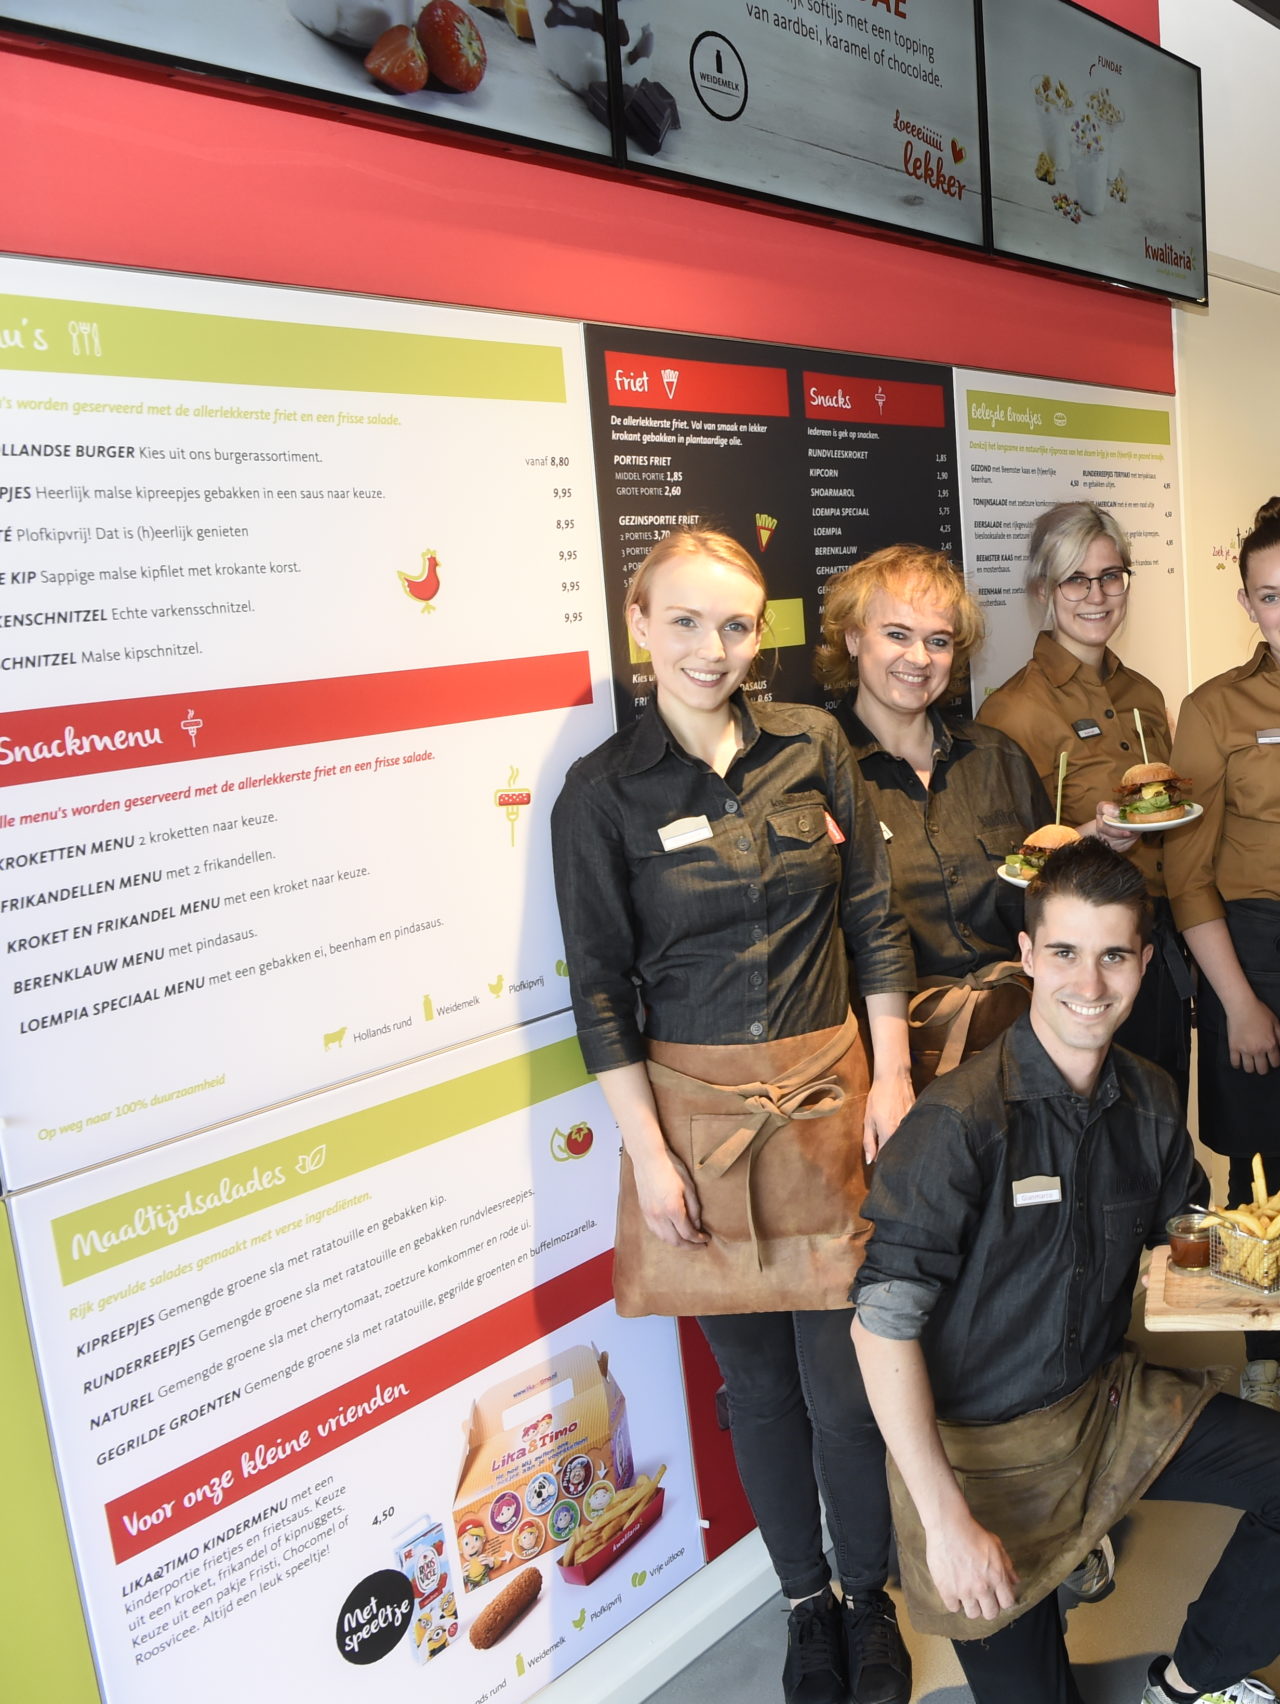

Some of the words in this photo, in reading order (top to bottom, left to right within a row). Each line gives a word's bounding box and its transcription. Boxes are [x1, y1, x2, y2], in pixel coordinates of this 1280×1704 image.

[808, 0, 843, 26] softijs
[847, 14, 869, 34] met
[871, 23, 891, 42] een
[894, 30, 934, 64] topping
[746, 3, 769, 23] van
[773, 13, 822, 45] aardbei,
[825, 27, 870, 61] karamel
[873, 48, 885, 66] of
[887, 53, 942, 88] chocolade.
[1098, 56, 1123, 75] FUNDAE
[700, 72, 740, 92] WEIDEMELK
[904, 141, 966, 200] lekker
[1144, 236, 1192, 271] kwalitaria
[614, 370, 649, 393] friet
[810, 388, 851, 409] Snacks
[610, 415, 621, 425] De
[622, 415, 671, 428] allerlekkerste
[671, 418, 689, 431] friet.
[690, 420, 702, 430] Vol
[717, 422, 738, 431] smaak
[739, 424, 747, 432] en
[748, 423, 767, 433] lekker
[611, 430, 641, 441] krokant
[642, 432, 676, 444] gebakken
[677, 433, 684, 443] in
[685, 434, 728, 447] plantaardige
[728, 436, 742, 445] olie.
[2, 443, 71, 457] LLANDSE
[76, 445, 135, 458] BURGER
[139, 447, 165, 459] Kies
[169, 447, 186, 460] uit
[189, 450, 211, 460] ons
[214, 448, 322, 464] burgerassortiment.
[525, 455, 548, 466] vanaf
[550, 456, 569, 467] 8,80
[613, 455, 648, 465] PORTIES
[649, 456, 671, 466] FRIET
[808, 448, 868, 459] RUNDVLEESKROKET
[615, 471, 641, 480] MIDDEL
[642, 472, 664, 481] PORTIE
[666, 471, 682, 482] 1,85
[809, 468, 838, 477] KIPCORN
[970, 464, 991, 472] GEZOND
[553, 488, 572, 499] 9,95
[616, 486, 639, 495] GROTE
[640, 487, 663, 495] PORTIE
[664, 486, 681, 497] 2,60
[810, 488, 855, 497] SHOARMAROL
[618, 513, 678, 526] GEZINSPORTIE
[678, 514, 700, 525] FRIET
[812, 507, 840, 516] LOEMPIA
[841, 507, 869, 516] SPECIAAL
[556, 519, 574, 530] 8,95
[813, 527, 842, 536] LOEMPIA
[558, 550, 577, 561] 9,95
[11, 571, 36, 584] KIP
[40, 569, 95, 585] Sappige
[99, 567, 137, 580] malse
[140, 564, 184, 582] kipfilet
[187, 565, 212, 576] met
[214, 562, 266, 575] krokante
[269, 561, 301, 573] korst.
[561, 581, 580, 592] 9,95
[564, 611, 582, 623] 9,95
[7, 928, 69, 954] KROKET
[73, 924, 92, 939] EN
[97, 906, 176, 934] FRIKANDEL
[179, 896, 220, 916] MENU
[224, 892, 247, 905] met
[249, 888, 270, 900] een
[273, 879, 309, 895] kroket
[311, 874, 334, 887] naar
[337, 867, 370, 881] keuze.
[13, 958, 118, 994] BERENKLAUW
[121, 947, 164, 968] MENU
[168, 942, 193, 957] met
[195, 929, 257, 954] pindasaus.
[508, 976, 544, 994] Plofkipvrij
[436, 995, 480, 1016] Weidemelk
[353, 1023, 391, 1043] Hollands
[392, 1015, 412, 1030] rund
[71, 1166, 286, 1260] Maaltijdsalades
[76, 1313, 155, 1357] KIPREEPJES
[158, 1287, 224, 1321] Gemengde
[226, 1270, 266, 1296] groene
[269, 1261, 284, 1275] sla
[287, 1251, 309, 1267] met
[311, 1228, 364, 1257] ratatouille
[366, 1222, 379, 1234] en
[381, 1202, 427, 1231] gebakken
[429, 1195, 447, 1207] kip.
[122, 1500, 175, 1536] Voor
[183, 1469, 234, 1508] onze
[241, 1430, 311, 1478] kleine
[317, 1383, 409, 1437] vrienden
[203, 1498, 287, 1553] KINDERMENU
[291, 1486, 312, 1504] met
[314, 1475, 333, 1491] een
[372, 1506, 395, 1527] 4,50
[124, 1567, 200, 1614] kinderportie
[202, 1543, 243, 1571] frietjes
[246, 1534, 260, 1547] en
[262, 1506, 312, 1537] frietsaus.
[314, 1486, 346, 1508] Keuze
[649, 1563, 663, 1577] Vrije
[664, 1547, 685, 1567] uitloop
[135, 1625, 200, 1665] Roosvicee.
[203, 1599, 234, 1627] Altijd
[236, 1589, 257, 1606] een
[259, 1573, 283, 1593] leuk
[285, 1544, 330, 1578] speeltje!
[344, 1596, 378, 1633] Met
[590, 1593, 622, 1622] Plofkipvrij
[345, 1599, 411, 1652] speeltje
[527, 1635, 566, 1668] Weidemelk
